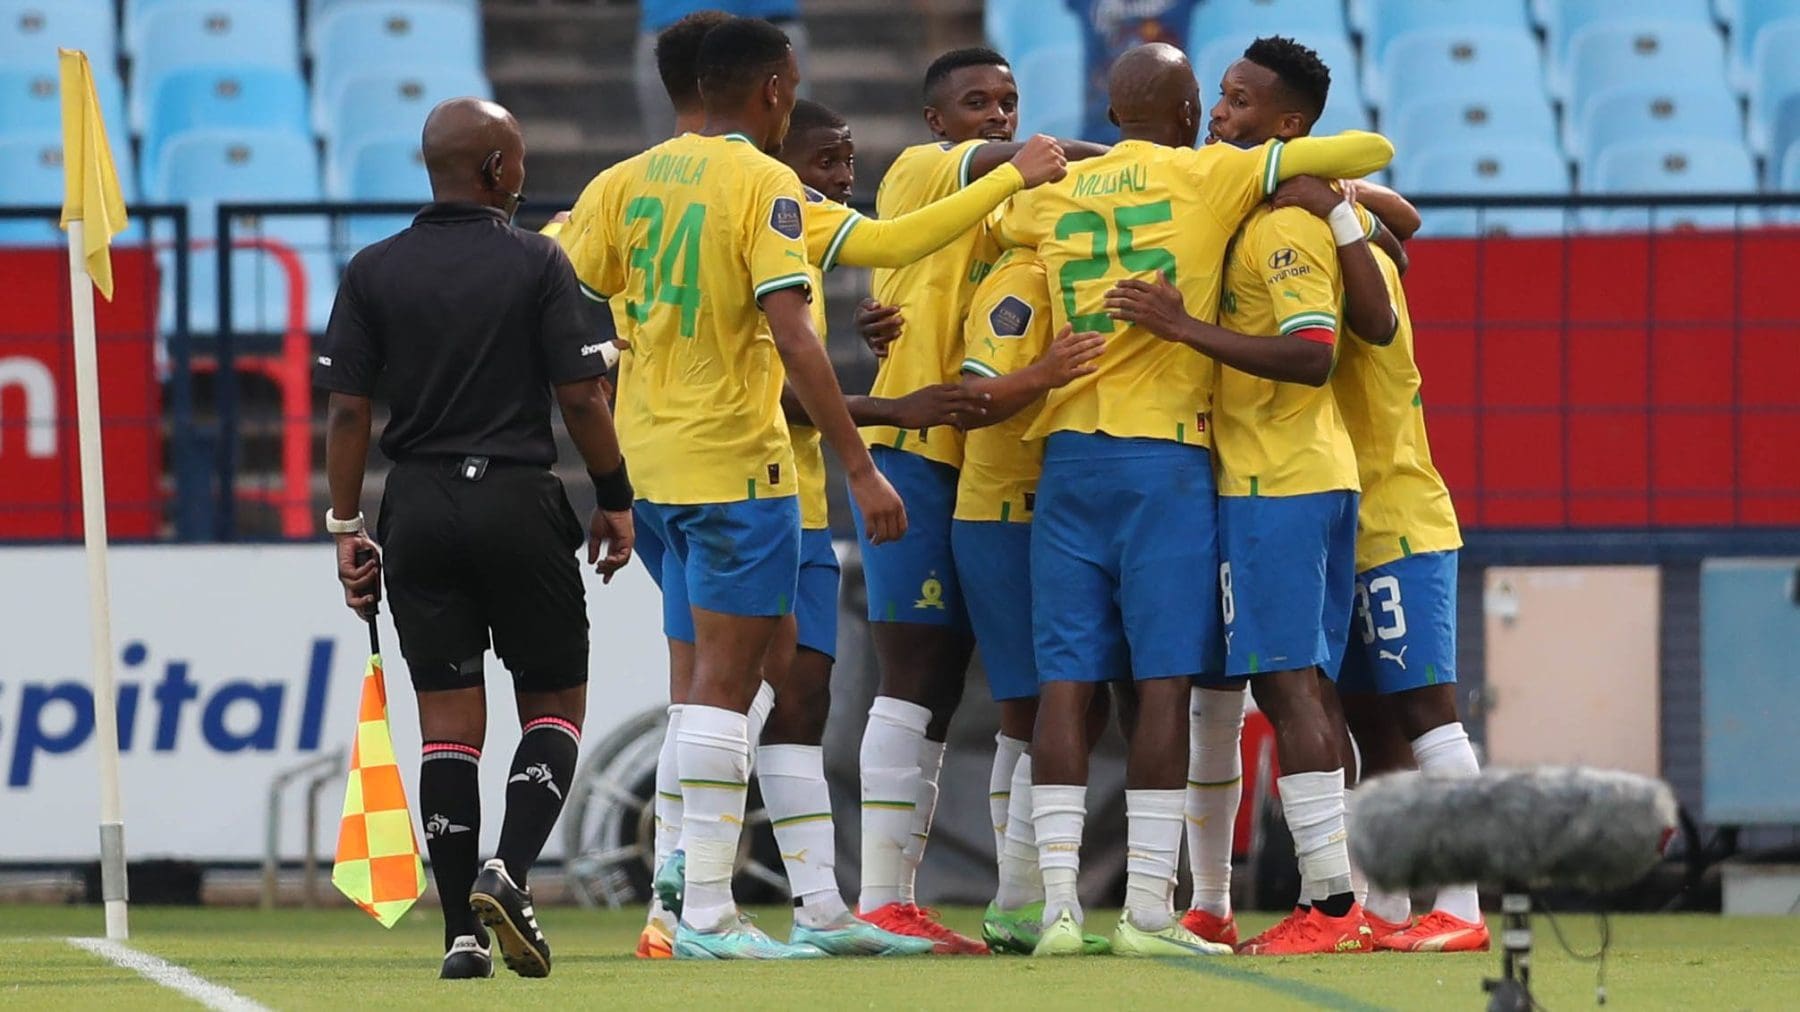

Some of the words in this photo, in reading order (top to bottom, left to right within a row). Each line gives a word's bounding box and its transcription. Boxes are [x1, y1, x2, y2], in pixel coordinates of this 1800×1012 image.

[644, 153, 708, 185] MVALA
[624, 196, 706, 337] 34
[1055, 200, 1176, 333] 25
[1267, 265, 1311, 284] HYUNDAI
[1219, 561, 1235, 625] 8
[1354, 575, 1407, 645] 33
[0, 637, 335, 787] pital
